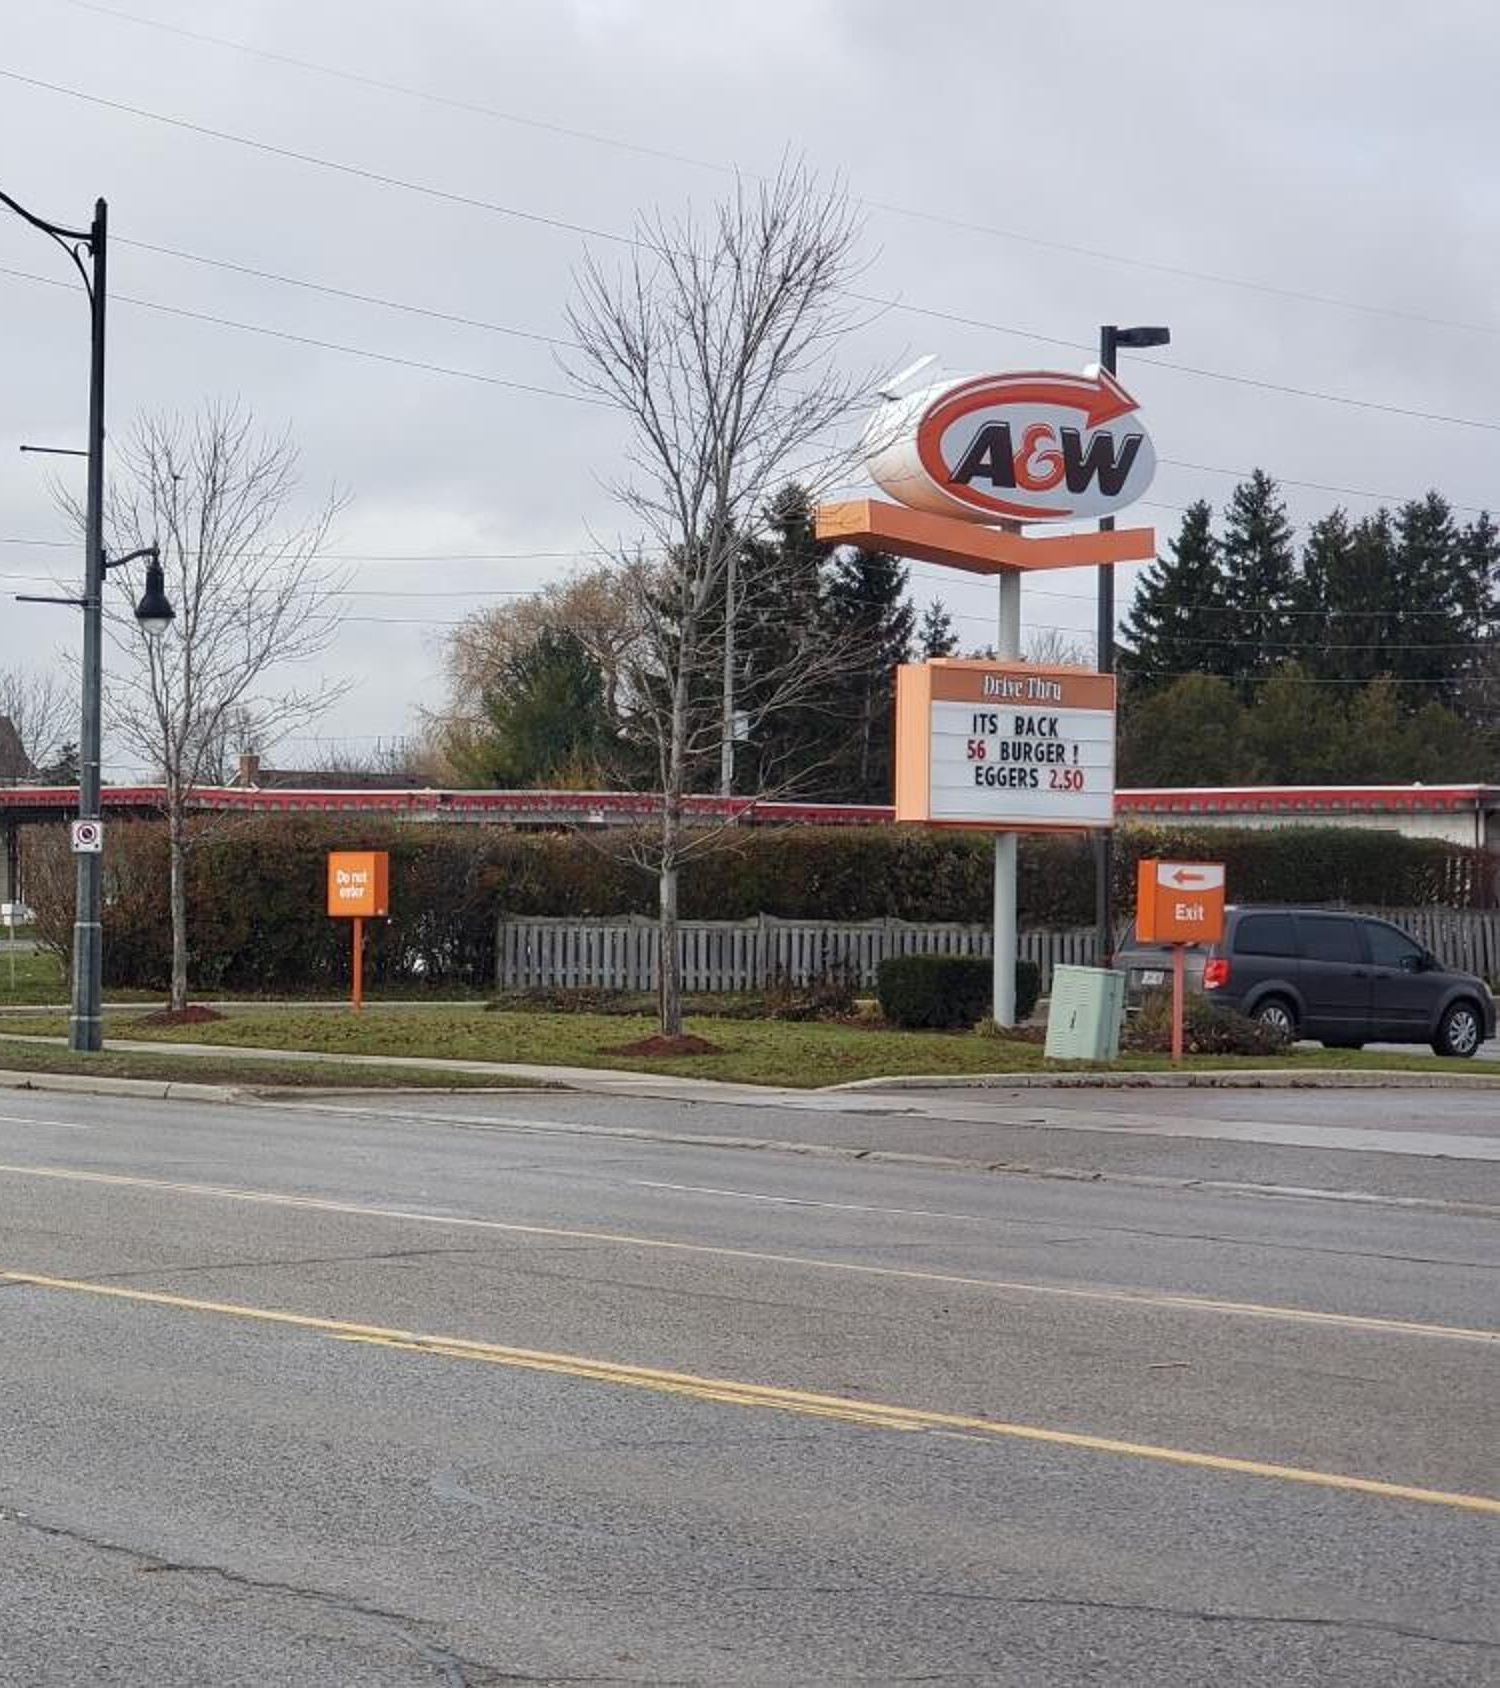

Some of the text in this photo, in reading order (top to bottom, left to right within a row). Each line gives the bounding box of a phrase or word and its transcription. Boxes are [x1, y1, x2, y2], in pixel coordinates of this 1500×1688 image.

[950, 420, 1145, 497] A&W
[984, 674, 1061, 700] Drive Thru
[973, 714, 1059, 737] ITS BACK
[967, 740, 987, 759] 56
[1001, 742, 1065, 763] BURGER
[975, 766, 1084, 790] EGGERS 2.50
[337, 869, 367, 885] Do not
[339, 885, 365, 898] enter
[1175, 904, 1204, 921] Exit
